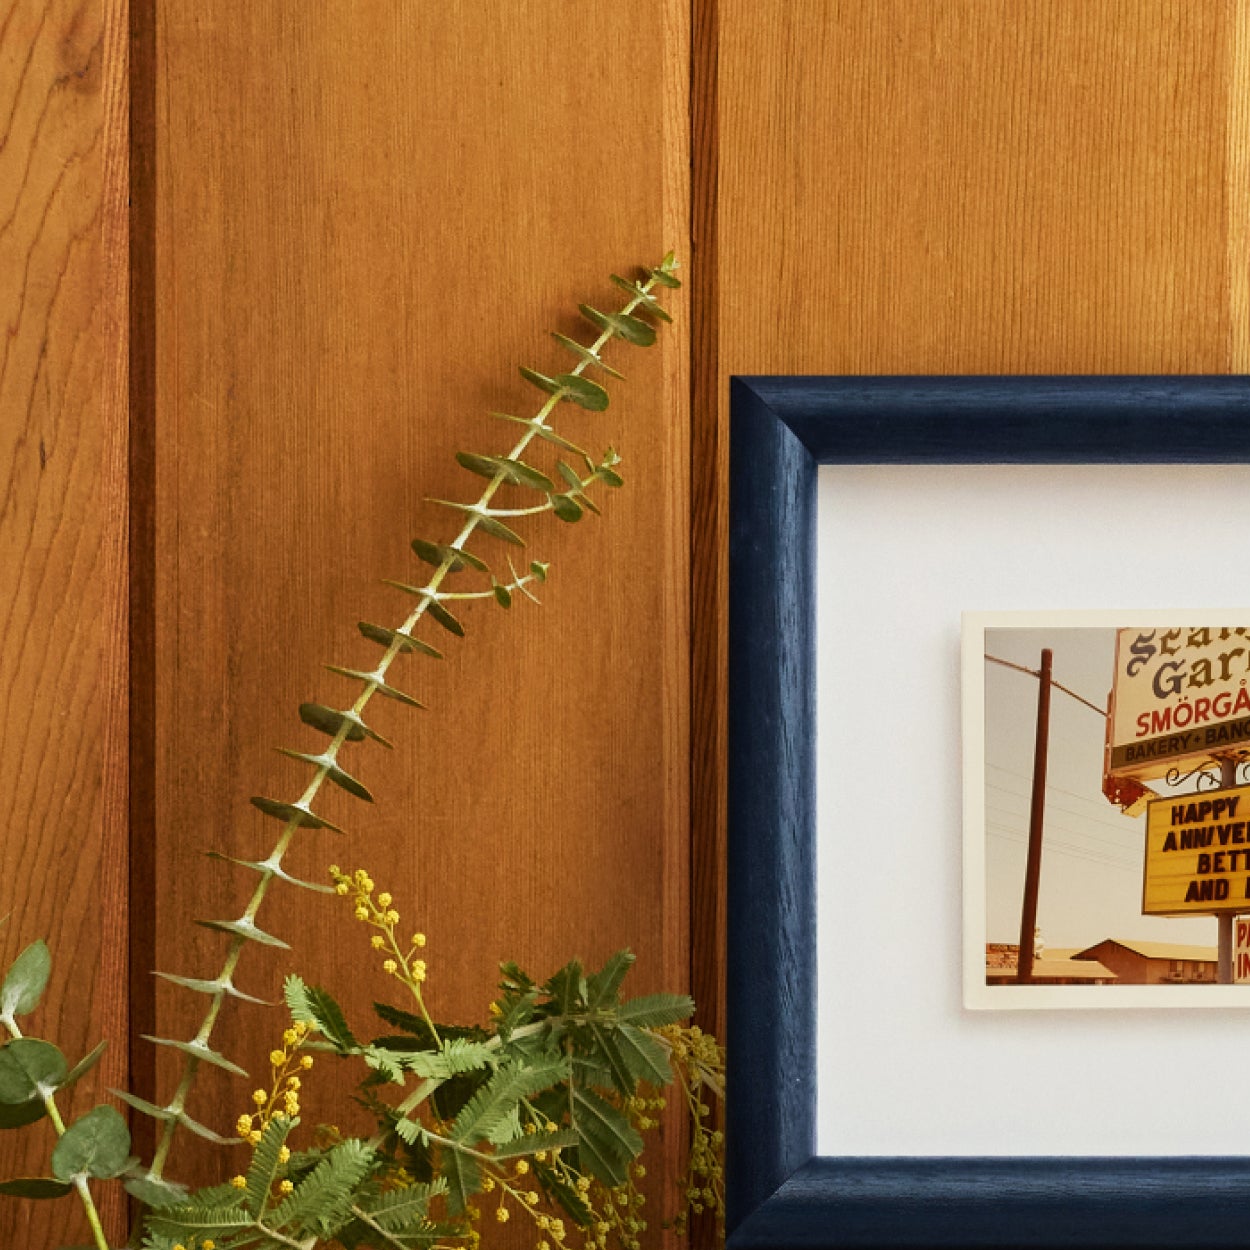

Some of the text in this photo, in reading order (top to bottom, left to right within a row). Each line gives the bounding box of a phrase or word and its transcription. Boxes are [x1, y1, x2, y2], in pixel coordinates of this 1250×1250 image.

[1125, 732, 1190, 763] BAKERY
[1171, 796, 1240, 826] HAPPY
[1184, 878, 1229, 902] AND
